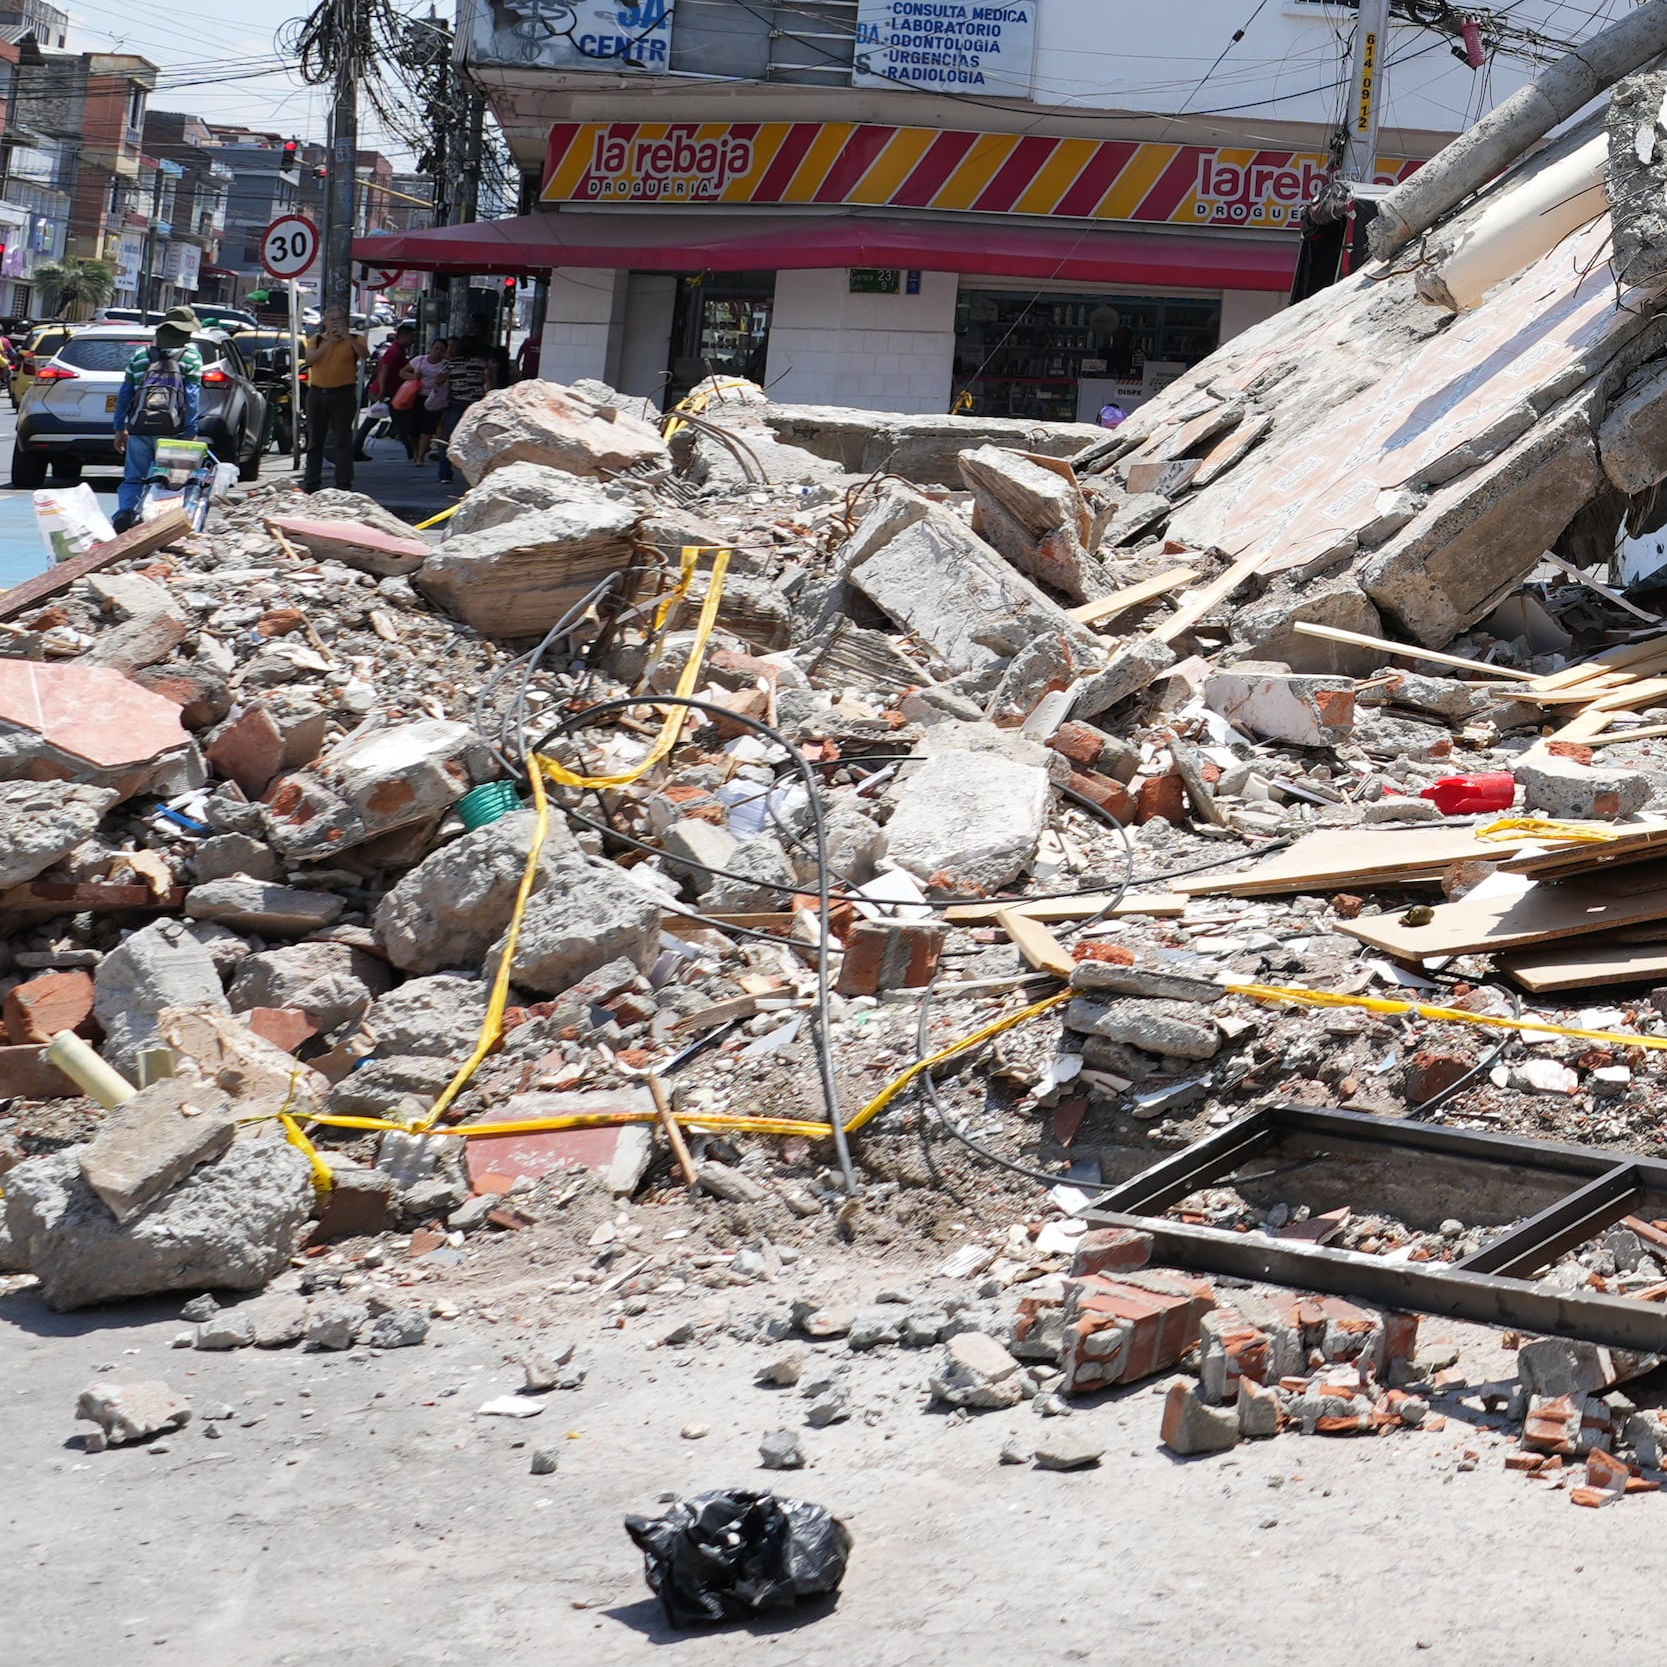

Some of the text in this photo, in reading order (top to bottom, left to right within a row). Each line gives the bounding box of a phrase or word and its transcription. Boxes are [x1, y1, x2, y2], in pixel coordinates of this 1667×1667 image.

[892, 1, 1028, 24] CONSULTA MEDICA
[890, 16, 1002, 38] LABORATORIO
[888, 49, 981, 69] URGENCIAS
[886, 66, 986, 85] RADIOLOGIA
[594, 133, 751, 191] la rebaja
[589, 181, 710, 195] DROGUERIA
[1200, 157, 1241, 198] la
[269, 230, 309, 264] 30
[877, 269, 893, 283] 23
